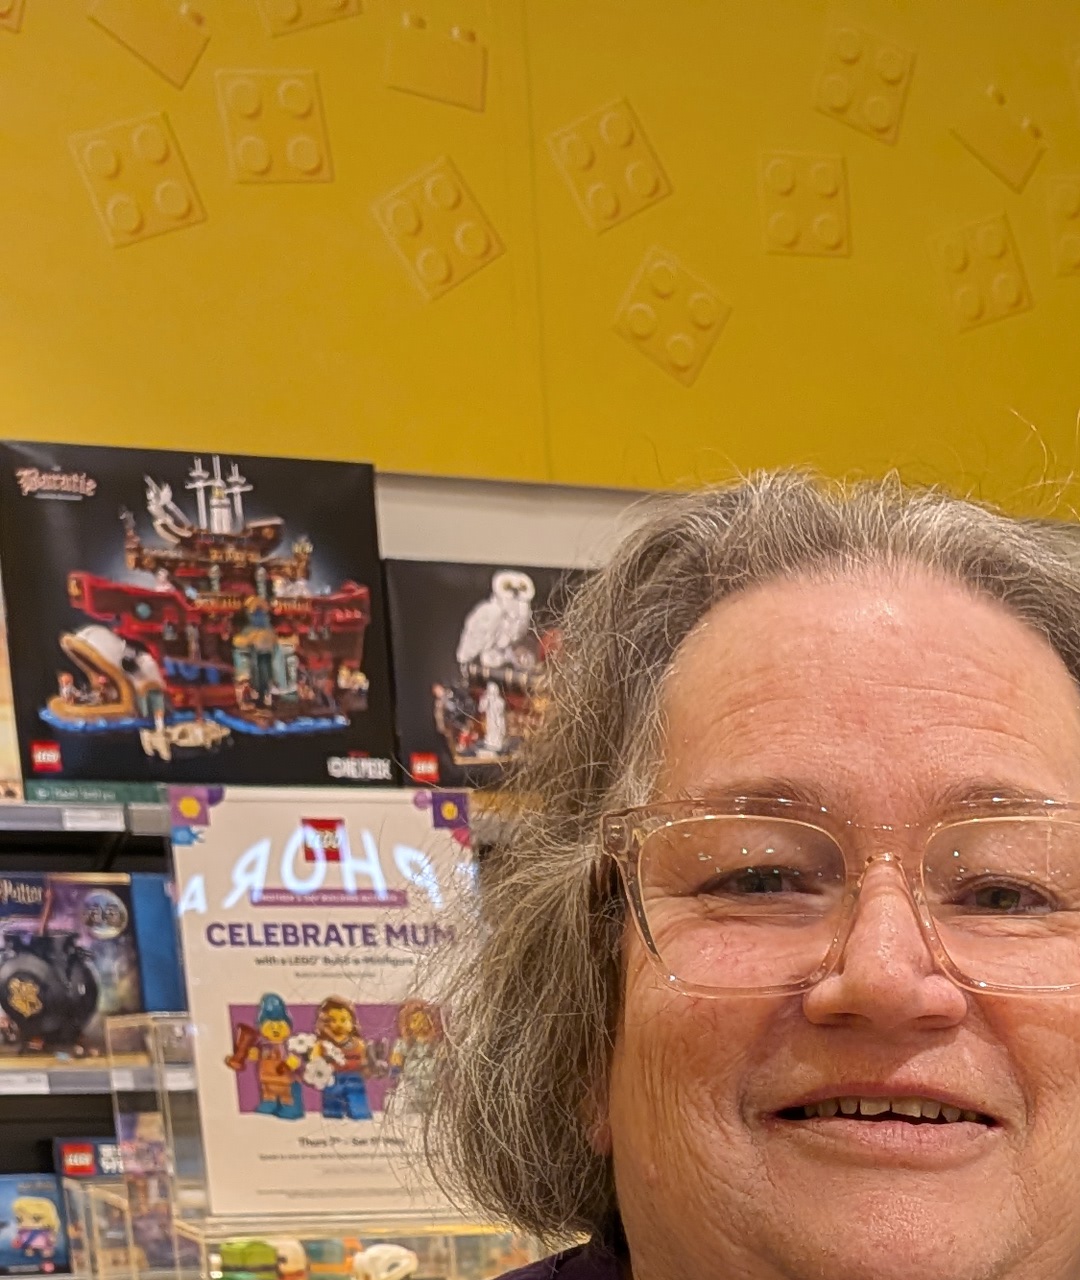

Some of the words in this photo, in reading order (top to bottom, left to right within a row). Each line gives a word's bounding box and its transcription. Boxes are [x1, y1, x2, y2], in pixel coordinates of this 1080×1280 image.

[16, 467, 97, 496] Baratie
[206, 922, 377, 947] CELEBRATE
[385, 922, 455, 947] MUM
